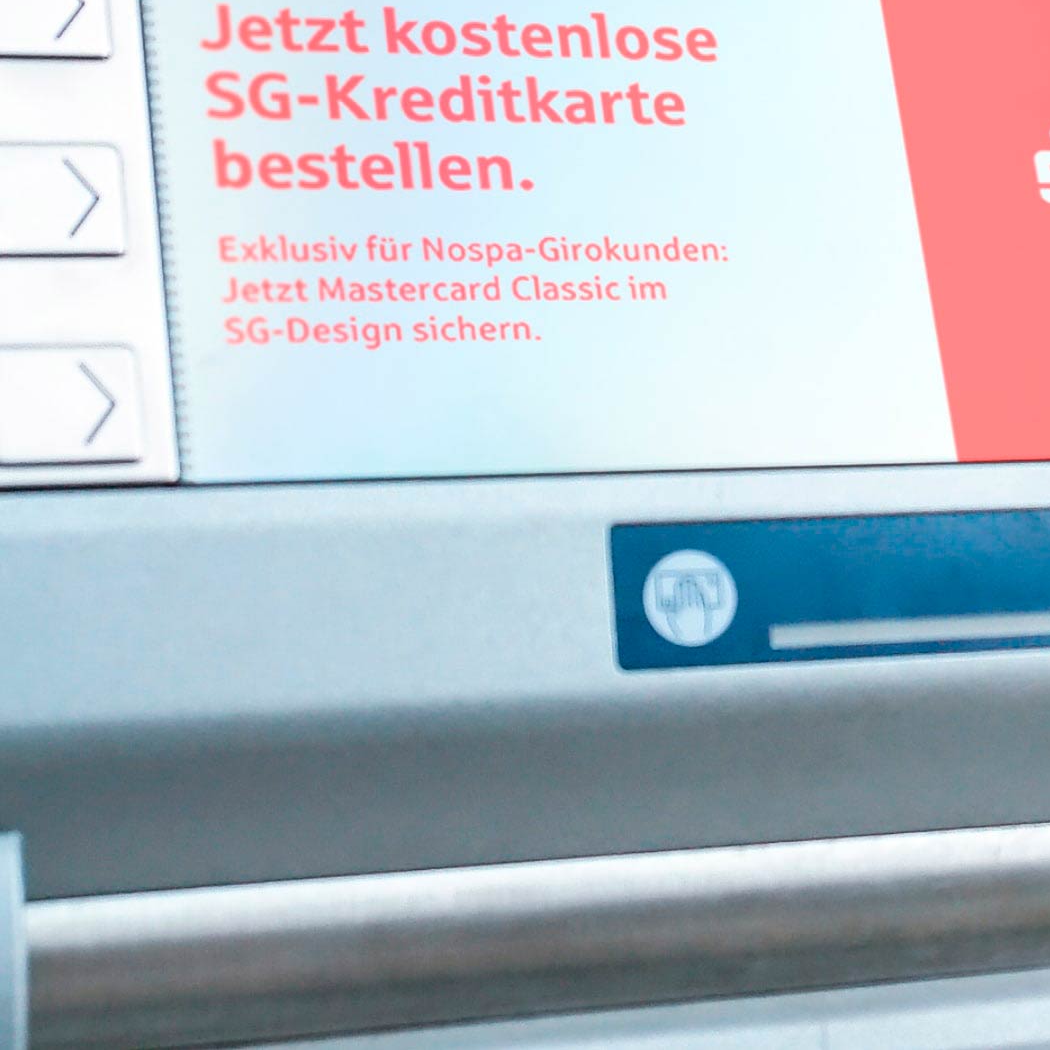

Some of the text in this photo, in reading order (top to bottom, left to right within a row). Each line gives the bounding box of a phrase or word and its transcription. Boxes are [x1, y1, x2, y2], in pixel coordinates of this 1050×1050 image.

[200, 3, 719, 63] Jetzt kostenlose
[205, 71, 687, 127] SG-Kreditkarte
[212, 138, 535, 193] bestellen.
[218, 235, 730, 268] Exklusiv für Nospa-Girokunden:
[221, 275, 668, 304] Jetzt Mastercard Classic im
[223, 315, 543, 350] SG-Design sichern.
